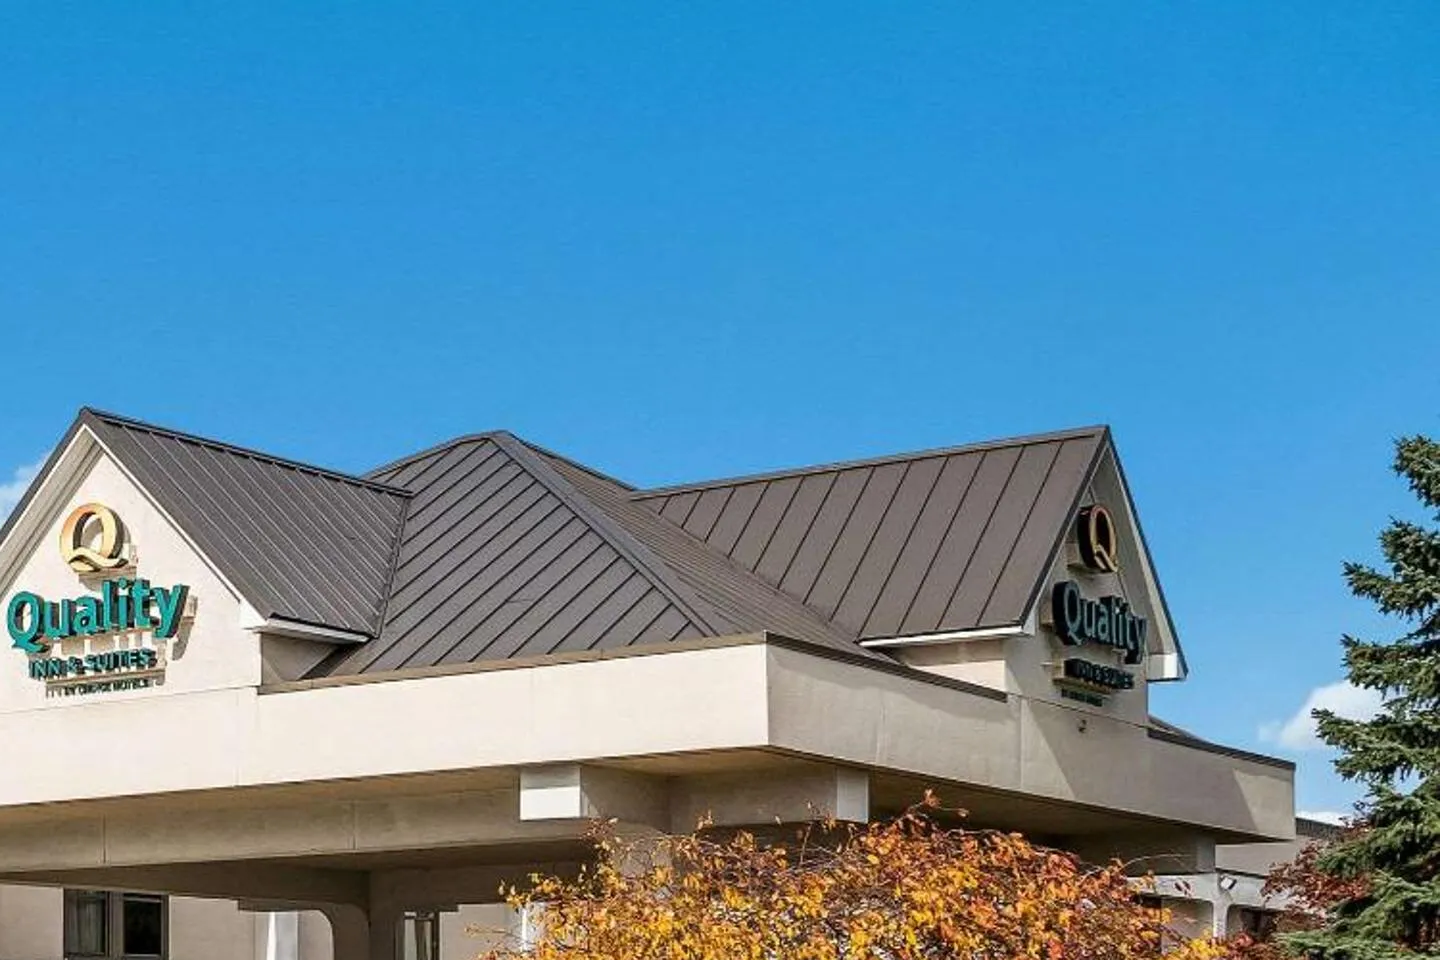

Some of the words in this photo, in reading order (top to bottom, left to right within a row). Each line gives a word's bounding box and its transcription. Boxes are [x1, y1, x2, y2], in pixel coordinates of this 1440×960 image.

[60, 503, 130, 572] Q
[7, 577, 191, 655] Quality
[1063, 580, 1147, 664] Quality
[84, 648, 157, 672] SUITES
